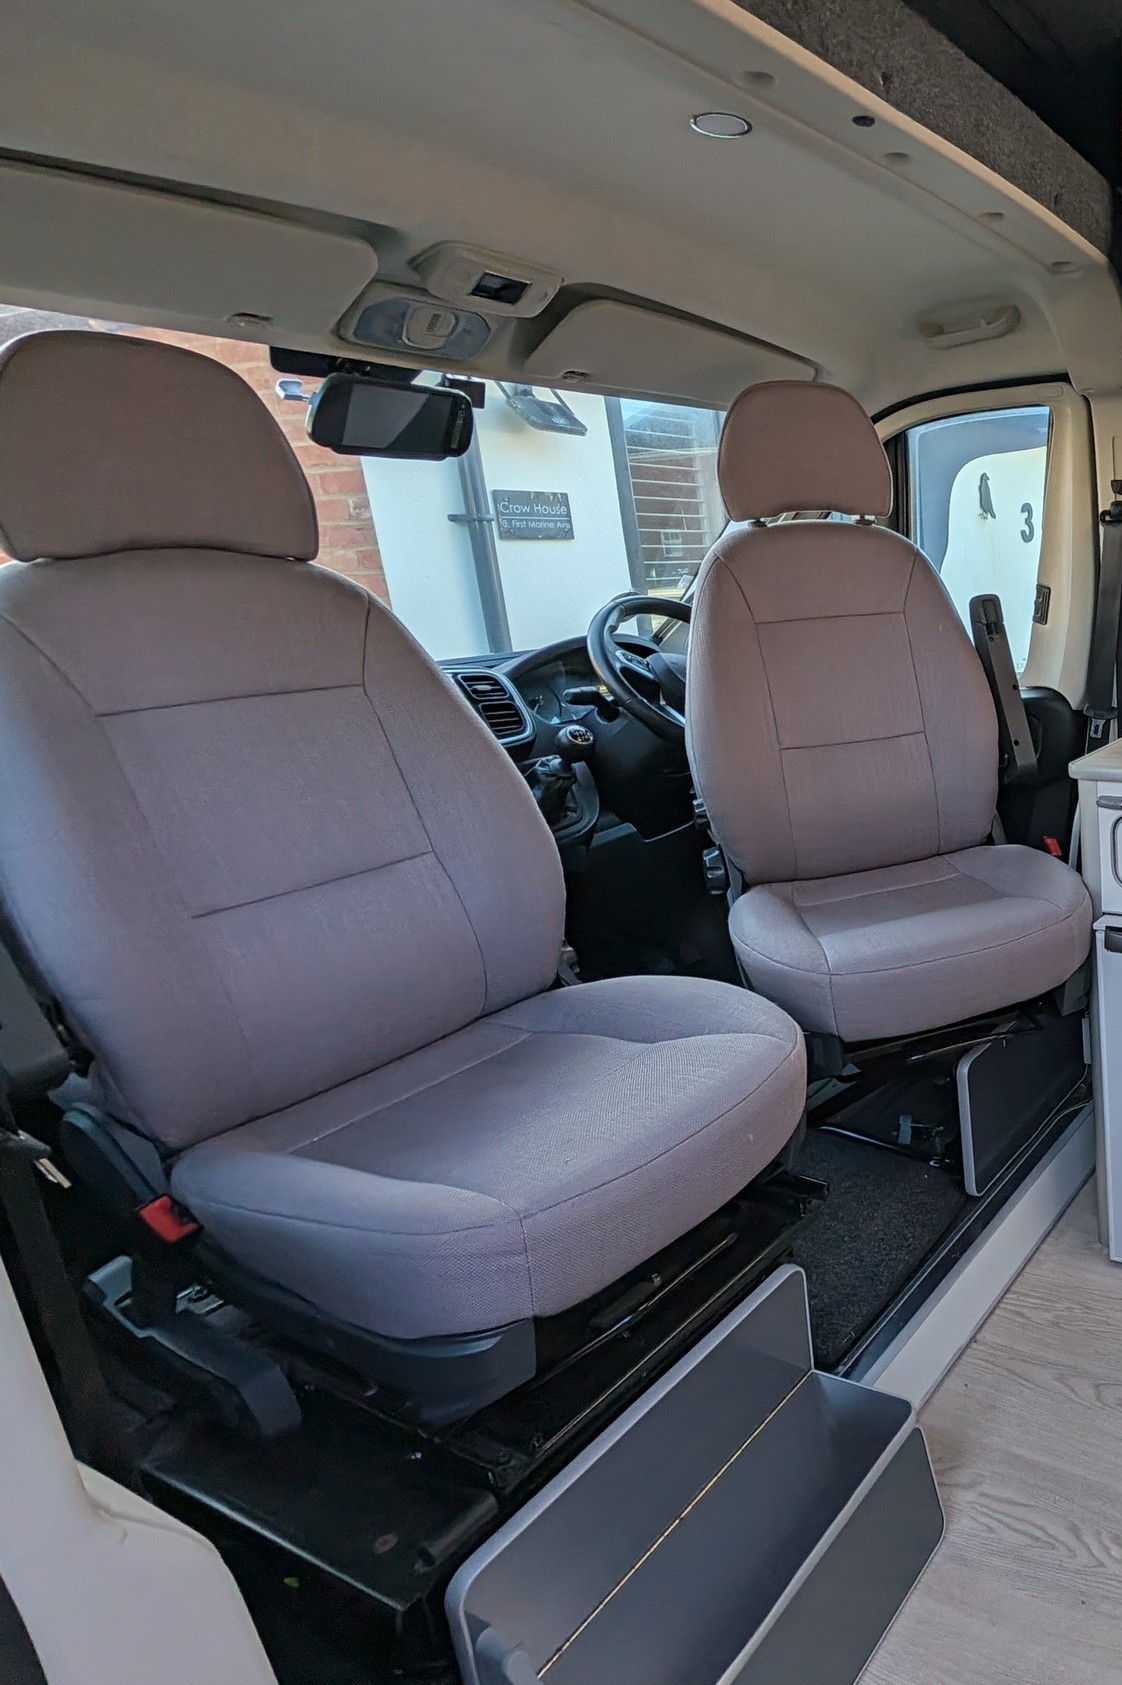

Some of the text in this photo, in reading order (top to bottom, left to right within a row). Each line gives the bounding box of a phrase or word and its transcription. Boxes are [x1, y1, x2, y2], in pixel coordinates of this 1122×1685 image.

[500, 501, 567, 515] Crow House
[511, 519, 526, 528] First
[528, 520, 554, 529] Marine
[556, 521, 570, 529] Ave
[1021, 502, 1034, 543] 3
